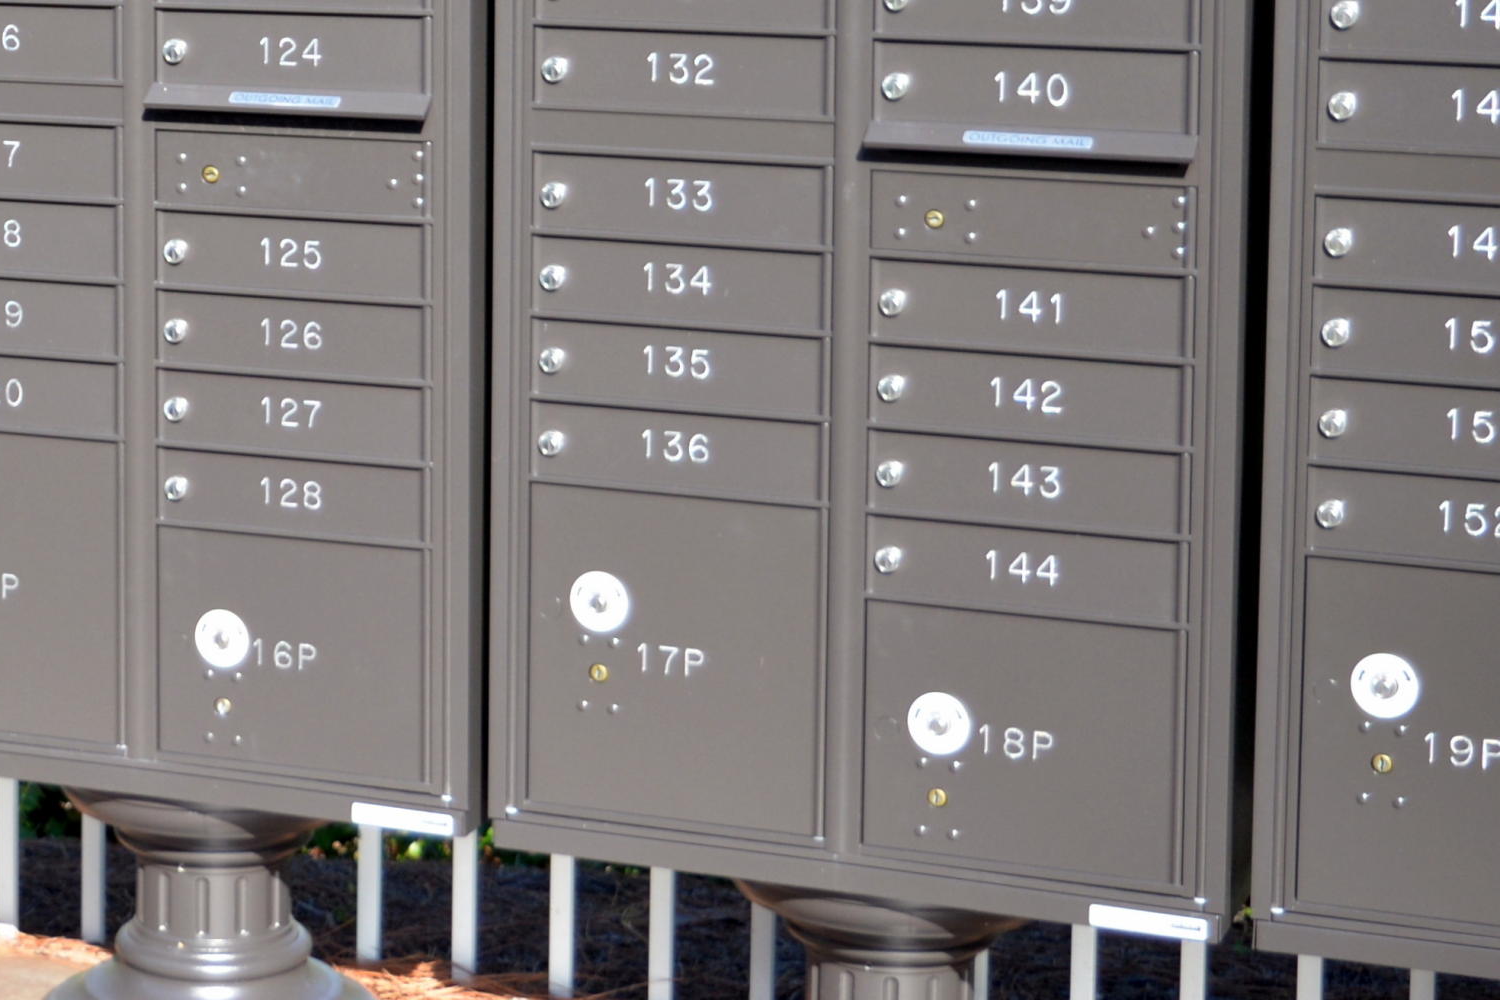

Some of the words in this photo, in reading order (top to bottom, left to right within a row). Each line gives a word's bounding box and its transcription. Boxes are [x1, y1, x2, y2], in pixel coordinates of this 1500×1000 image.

[259, 36, 323, 68] 124
[646, 51, 715, 87] 132
[233, 92, 302, 105] OUTGOING
[306, 96, 335, 107] MAIL
[994, 70, 1071, 108] 140
[968, 131, 1047, 146] OUTGOING
[1052, 136, 1087, 148] MAIL
[644, 177, 713, 212] 133
[260, 237, 323, 270] 125
[643, 261, 713, 297] 134
[995, 288, 1063, 325] 141
[260, 317, 323, 351] 126
[643, 344, 712, 381] 135
[260, 396, 322, 429] 127
[990, 376, 1064, 415] 142
[641, 428, 710, 464] 136
[260, 476, 323, 511] 128
[988, 461, 1062, 500] 143
[985, 549, 1060, 587] 144
[252, 637, 317, 671] 16P
[636, 642, 705, 678] 17P
[978, 723, 1054, 761] 18P
[1424, 731, 1500, 771] 19P
